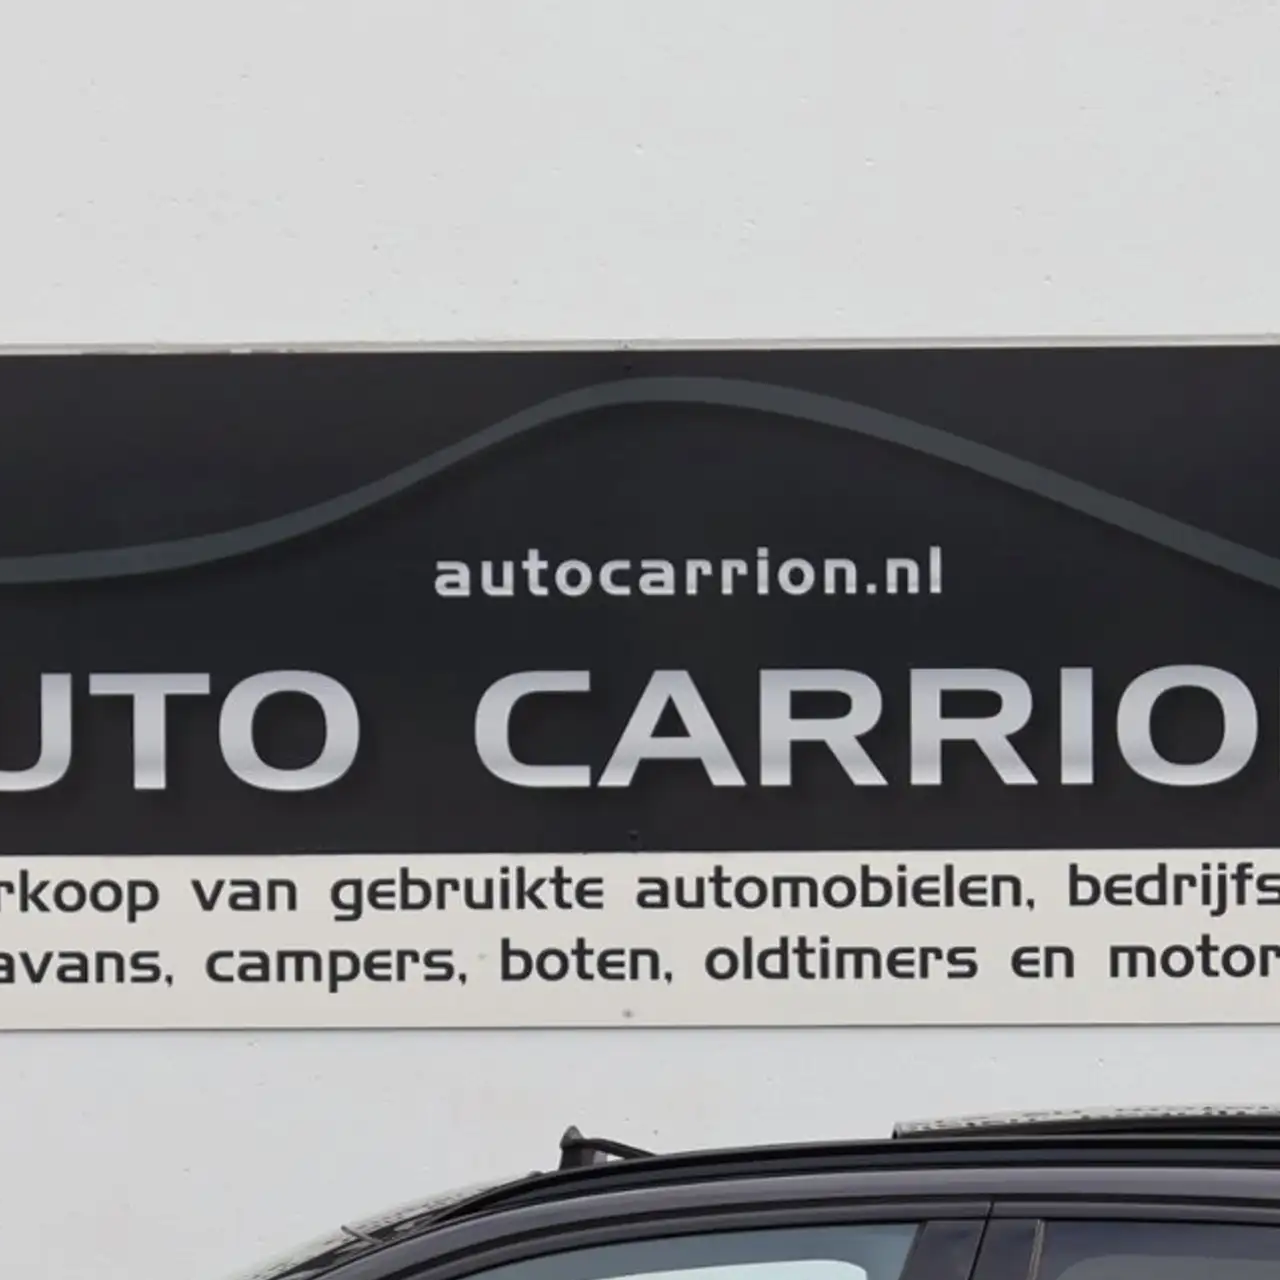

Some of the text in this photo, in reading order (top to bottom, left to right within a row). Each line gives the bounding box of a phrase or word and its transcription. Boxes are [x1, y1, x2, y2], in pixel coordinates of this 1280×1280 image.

[434, 546, 942, 598] autocarrion.nl
[191, 879, 297, 912] van
[330, 865, 604, 922] gebruikte
[636, 864, 1035, 911] automobielen,
[206, 946, 468, 994] campers,
[501, 937, 673, 984] boten,
[705, 935, 978, 980] oldtimers
[1011, 945, 1074, 978] en
